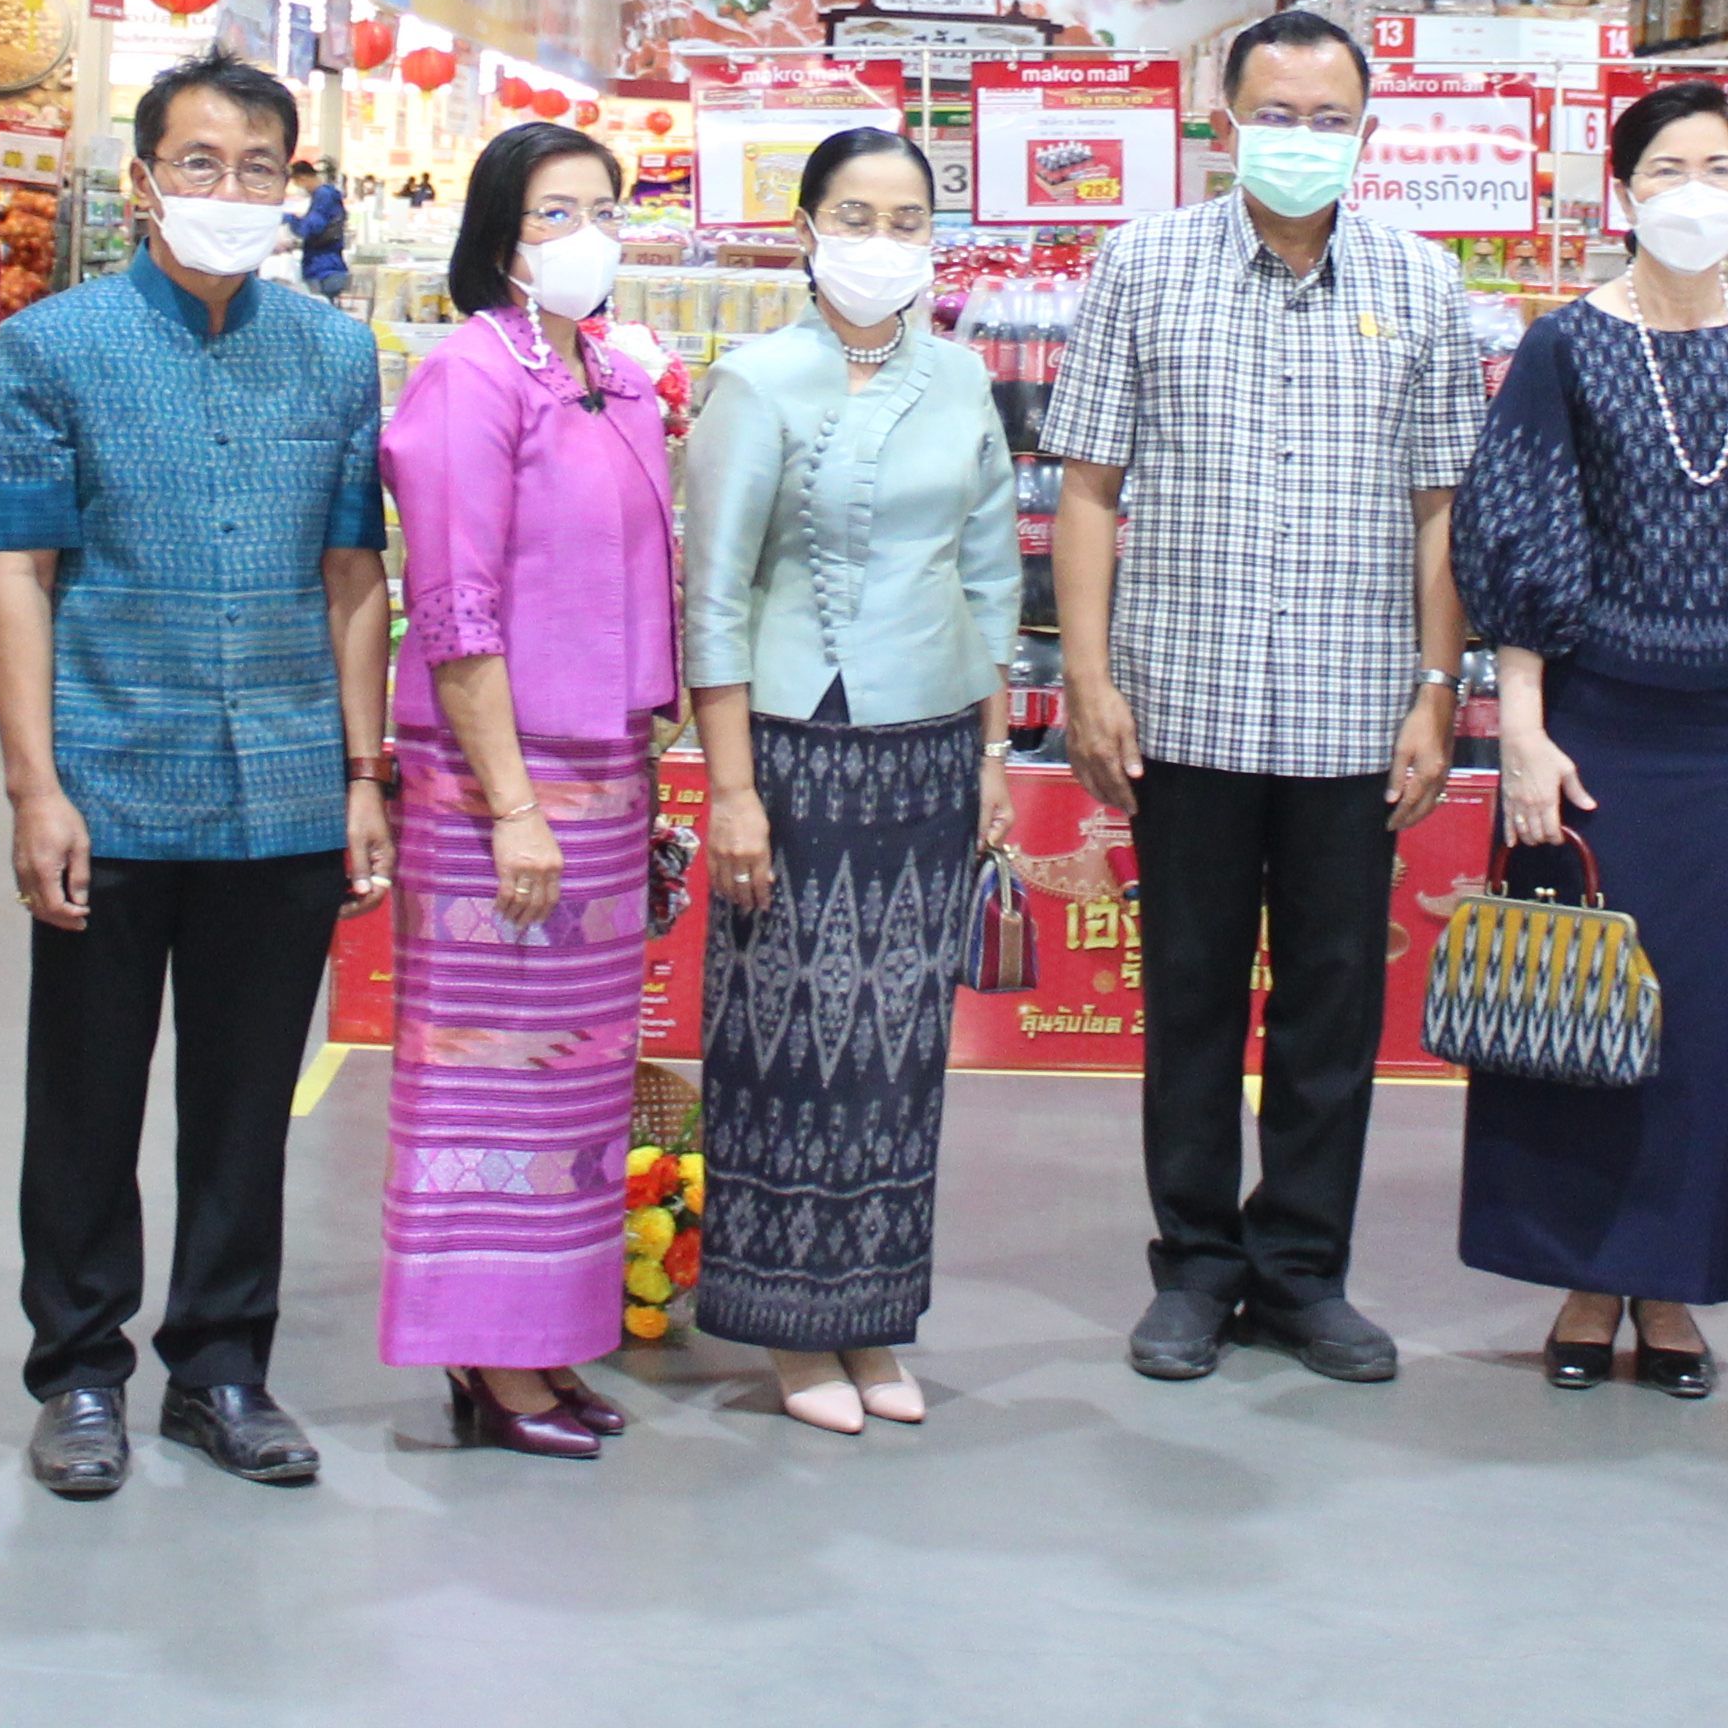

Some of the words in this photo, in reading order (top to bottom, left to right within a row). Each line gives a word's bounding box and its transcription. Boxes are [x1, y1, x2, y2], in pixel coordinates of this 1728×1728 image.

[1376, 21, 1404, 47] 13
[1605, 29, 1630, 55] 14
[741, 66, 804, 84] makro
[1022, 65, 1084, 83] makro
[1087, 64, 1130, 83] mail
[1377, 76, 1438, 93] makro
[1585, 112, 1597, 149] 6
[942, 164, 969, 193] 3
[1340, 174, 1528, 212] ูคิดธุรกิจคุณ
